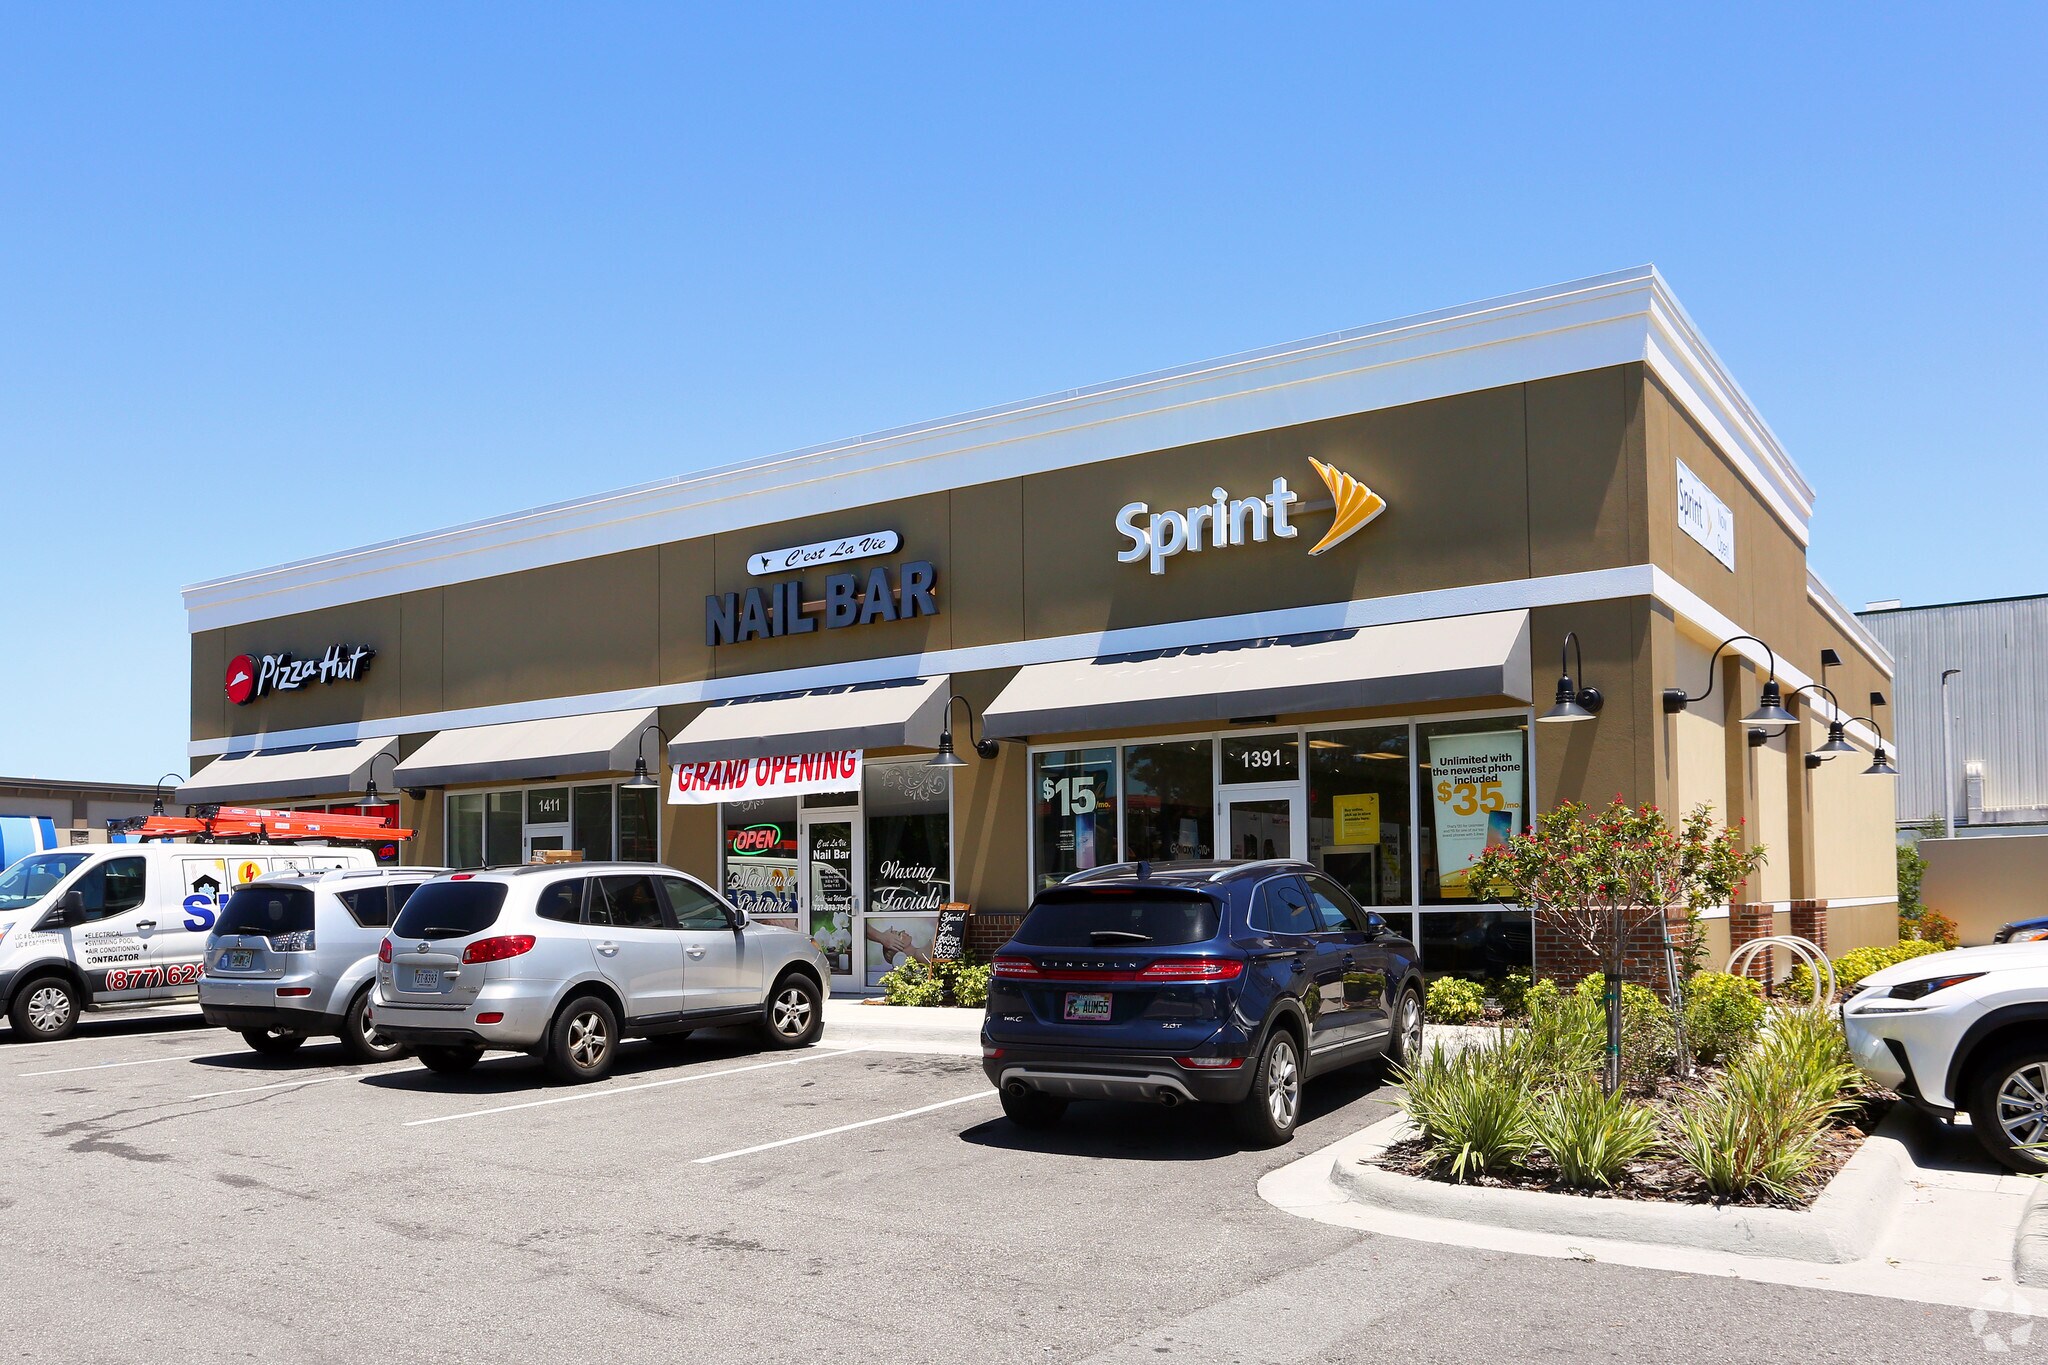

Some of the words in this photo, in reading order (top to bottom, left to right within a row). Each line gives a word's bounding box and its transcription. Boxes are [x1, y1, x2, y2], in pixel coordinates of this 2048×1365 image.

[1679, 478, 1703, 529] Sprint
[1115, 476, 1298, 575] Sprint
[785, 548, 826, 567] C'est
[829, 541, 855, 557] La
[859, 537, 886, 552] Vie
[705, 580, 818, 646] NAIL
[825, 560, 940, 630] BAR
[257, 653, 317, 695] Pizza
[316, 645, 369, 684] Hut
[1241, 749, 1281, 768] 1391
[1440, 754, 1488, 766] Unlimited
[1490, 753, 1512, 763] with
[678, 759, 749, 792] GRAND
[755, 749, 857, 787] OPENING
[1433, 767, 1448, 776] the
[1450, 765, 1486, 775] newest
[1488, 764, 1520, 774] phone
[1454, 774, 1498, 785] included
[538, 798, 560, 812] 1411
[736, 829, 776, 849] OPEN
[813, 849, 831, 860] Nail
[834, 849, 850, 860] Bar
[731, 867, 796, 889] Manicure
[880, 860, 936, 884] Waxing
[738, 893, 790, 912] Pedicure
[878, 887, 940, 910] Facials
[88, 931, 123, 939] ELECTRICAL
[88, 939, 118, 947] SWIMMING
[100, 945, 140, 953] CONDITIONING
[87, 954, 139, 964] CONTRACTOR
[105, 965, 165, 992] (877)
